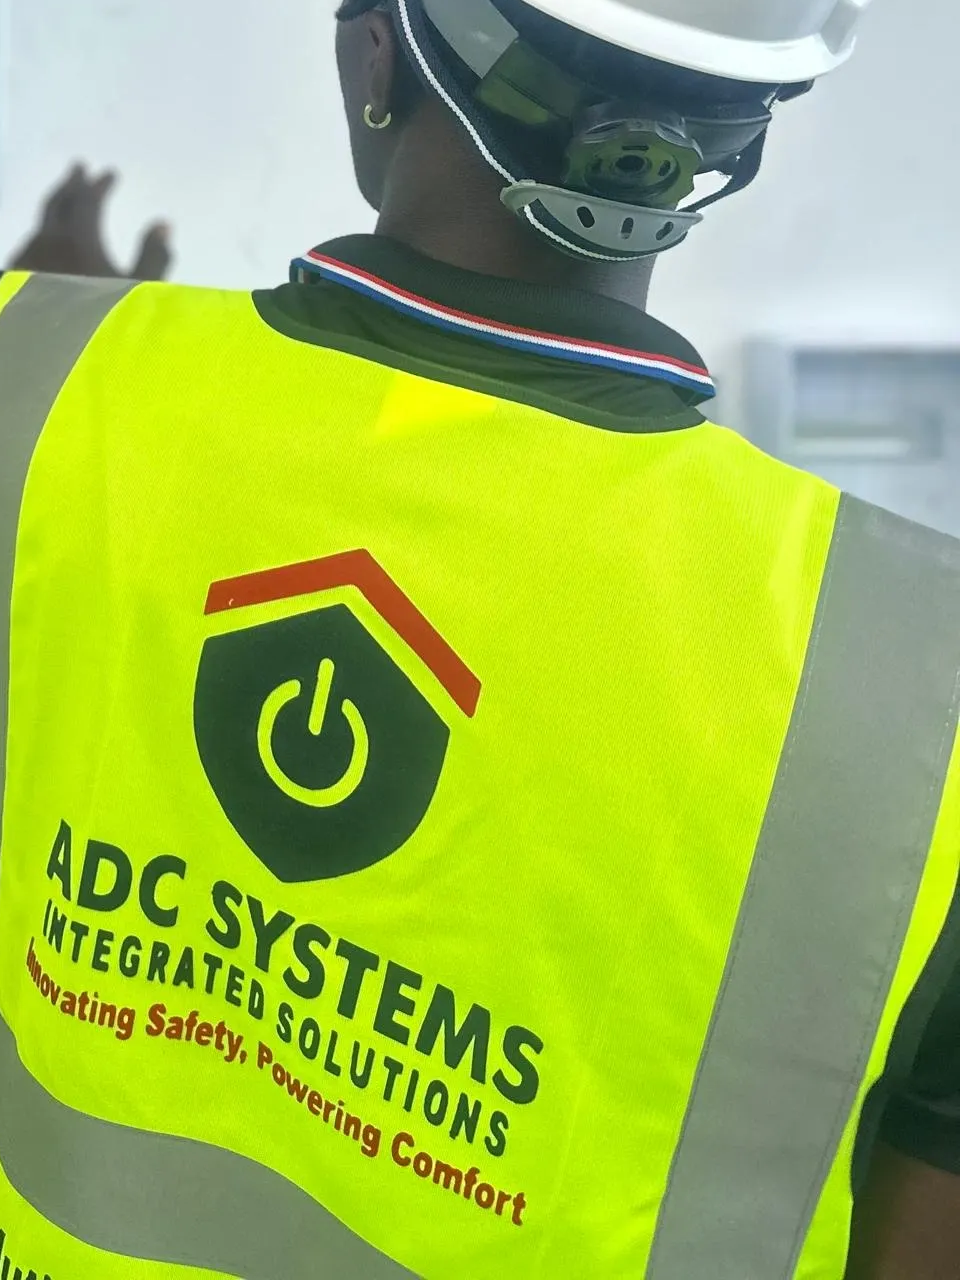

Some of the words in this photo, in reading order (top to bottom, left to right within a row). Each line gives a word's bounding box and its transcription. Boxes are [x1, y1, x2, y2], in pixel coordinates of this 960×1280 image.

[26, 937, 136, 1041] Innovating
[145, 1003, 248, 1064] Safety,
[257, 1041, 381, 1158] Powering
[391, 1132, 526, 1226] Comfort
[42, 899, 264, 1020] INTEGRATED
[276, 1002, 509, 1157] SOLUTIONS
[46, 819, 187, 928] ADC
[205, 880, 544, 1105] SYSTEMS
